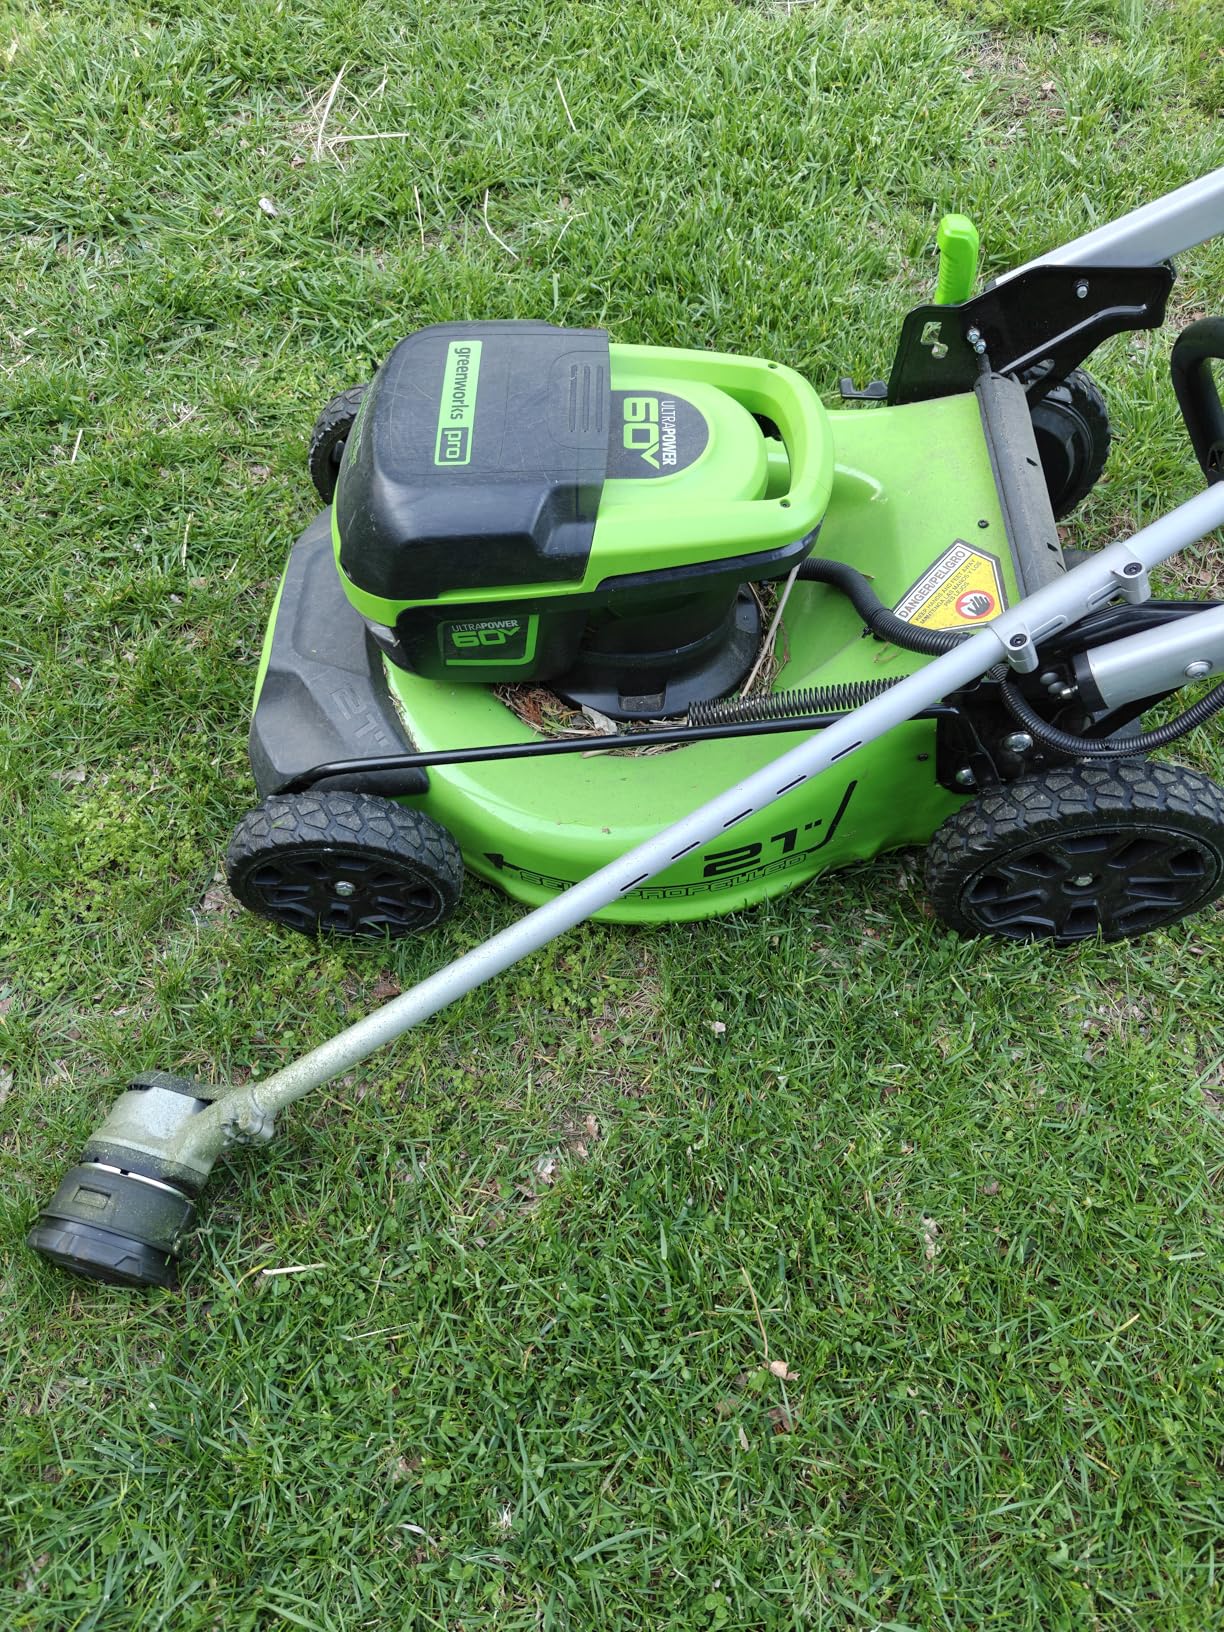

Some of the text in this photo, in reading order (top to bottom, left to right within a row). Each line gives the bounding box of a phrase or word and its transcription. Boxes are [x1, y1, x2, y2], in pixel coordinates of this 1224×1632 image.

[444, 347, 471, 460] greenworks pro
[623, 397, 660, 470] 60V
[660, 400, 677, 466] ULTRAPOWER
[898, 550, 966, 619] DANGER/PELIGRO
[915, 559, 975, 621] KEEP HANDS AND FEET AWAY
[451, 619, 519, 632] ULTRAPOWER
[451, 626, 520, 648] 60V
[703, 818, 823, 878] 21"
